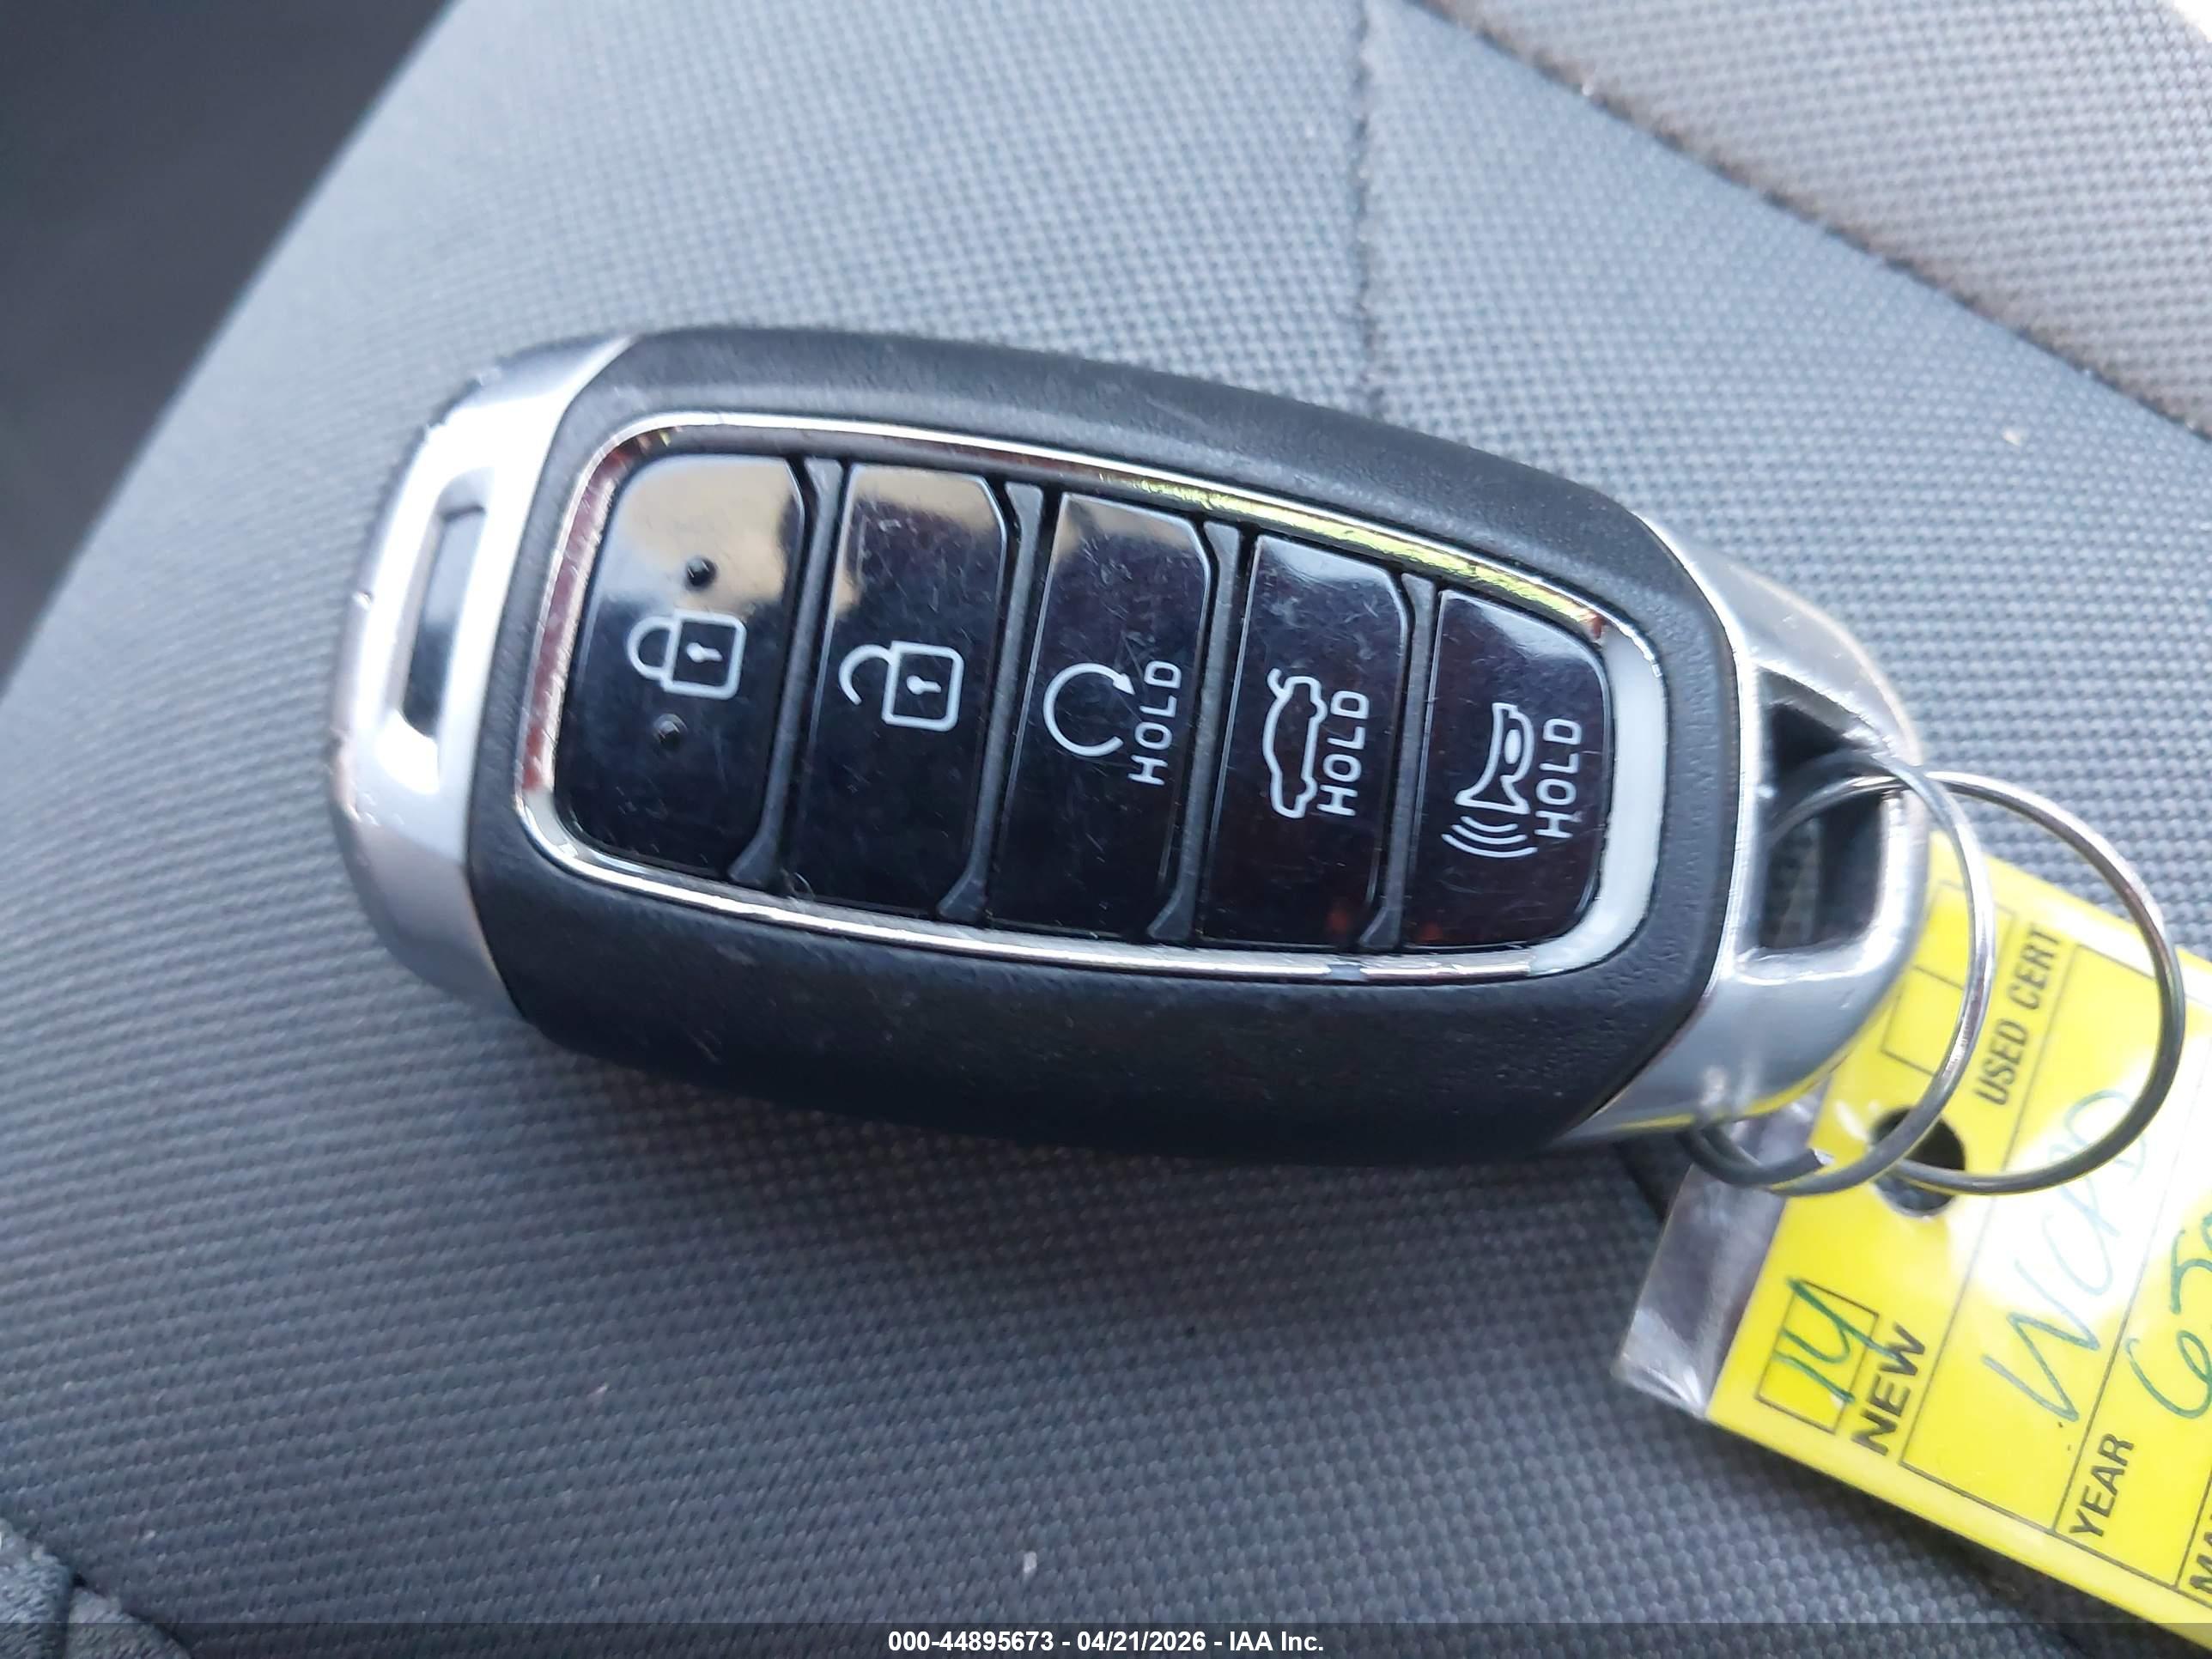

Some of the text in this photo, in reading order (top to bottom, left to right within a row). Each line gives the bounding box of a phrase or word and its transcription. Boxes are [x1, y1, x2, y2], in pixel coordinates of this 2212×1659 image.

[1127, 659, 1182, 786] HOLD
[1316, 690, 1370, 817] HOLD
[1534, 717, 1583, 839] HOLD
[1974, 927, 2063, 1108] USED CERT
[1851, 1324, 1928, 1456] NEW
[2069, 1432, 2136, 1538] YEAR
